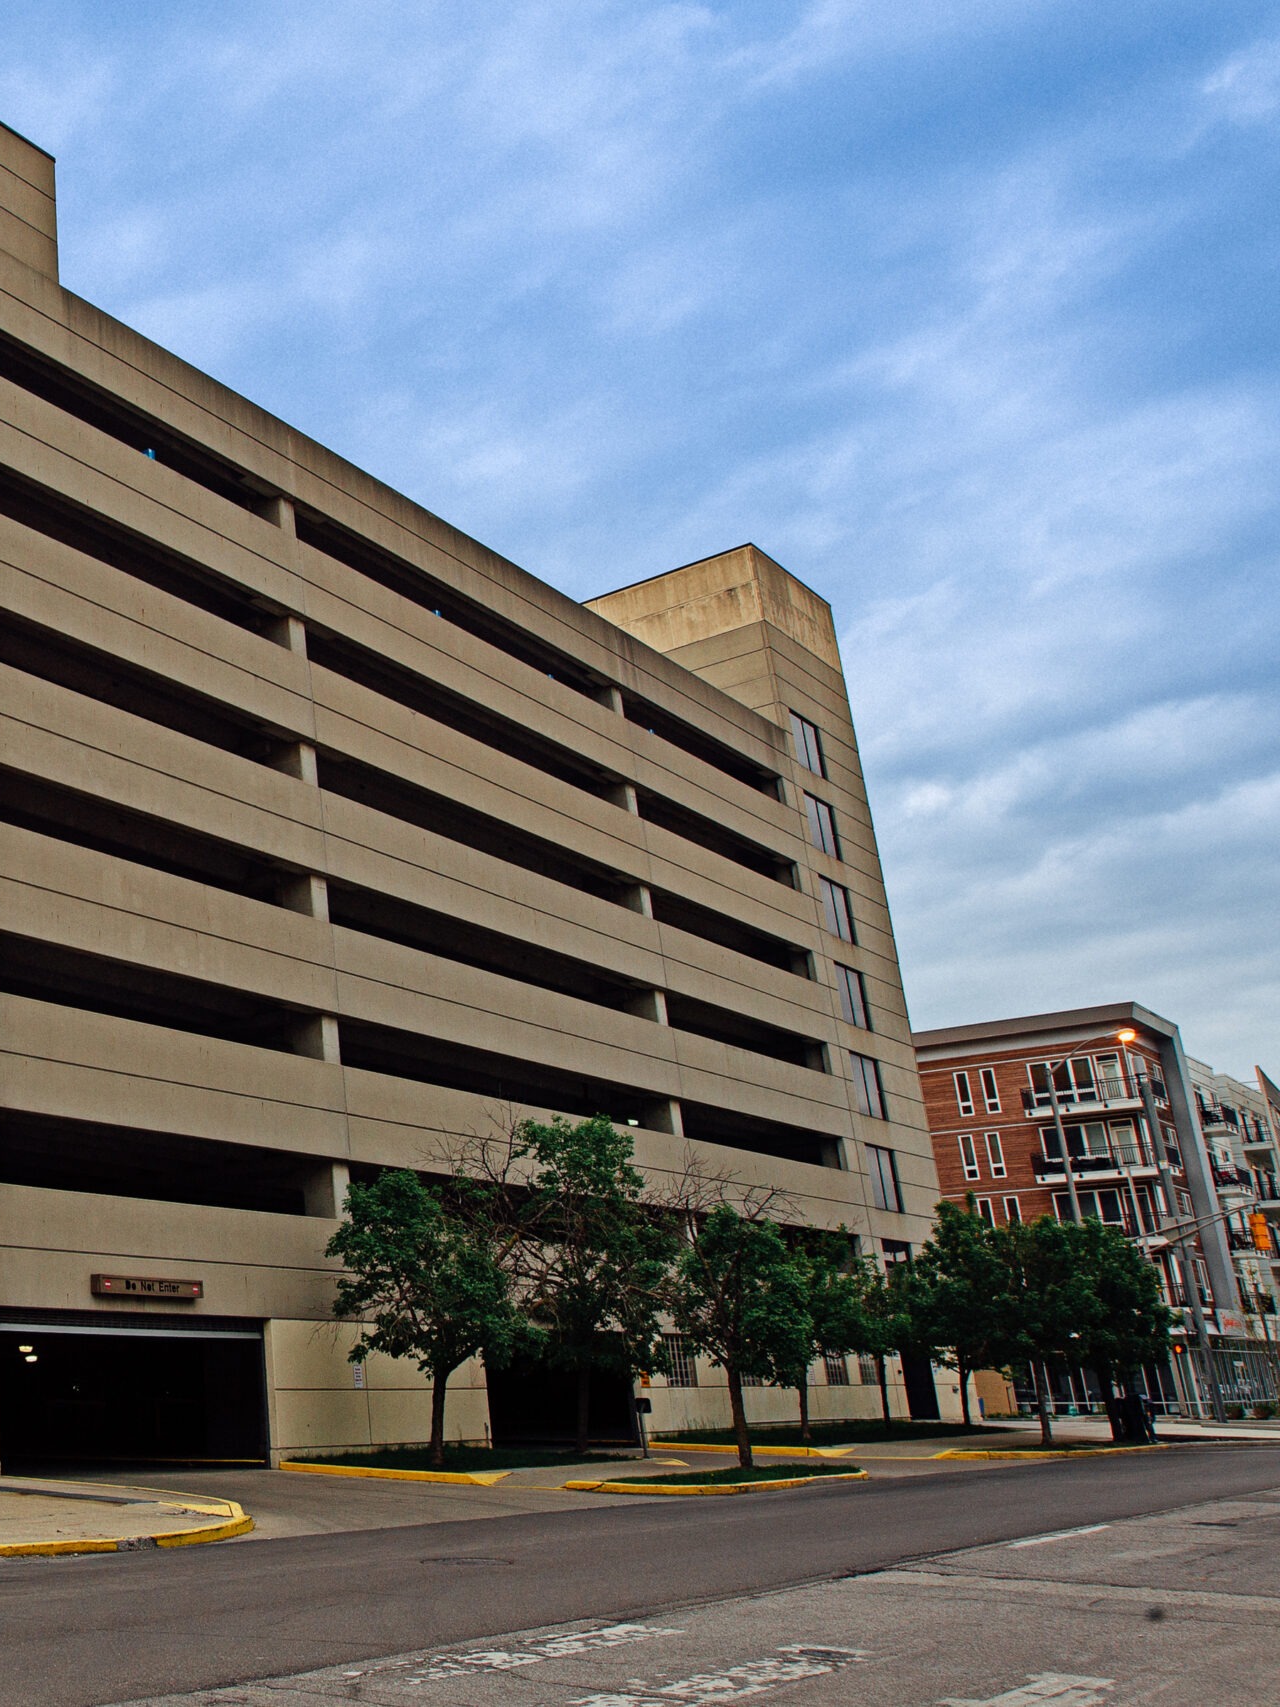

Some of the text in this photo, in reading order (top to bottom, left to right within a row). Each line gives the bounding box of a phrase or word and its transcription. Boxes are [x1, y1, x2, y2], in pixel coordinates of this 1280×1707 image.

[125, 1280, 180, 1293] Do Not Enter
